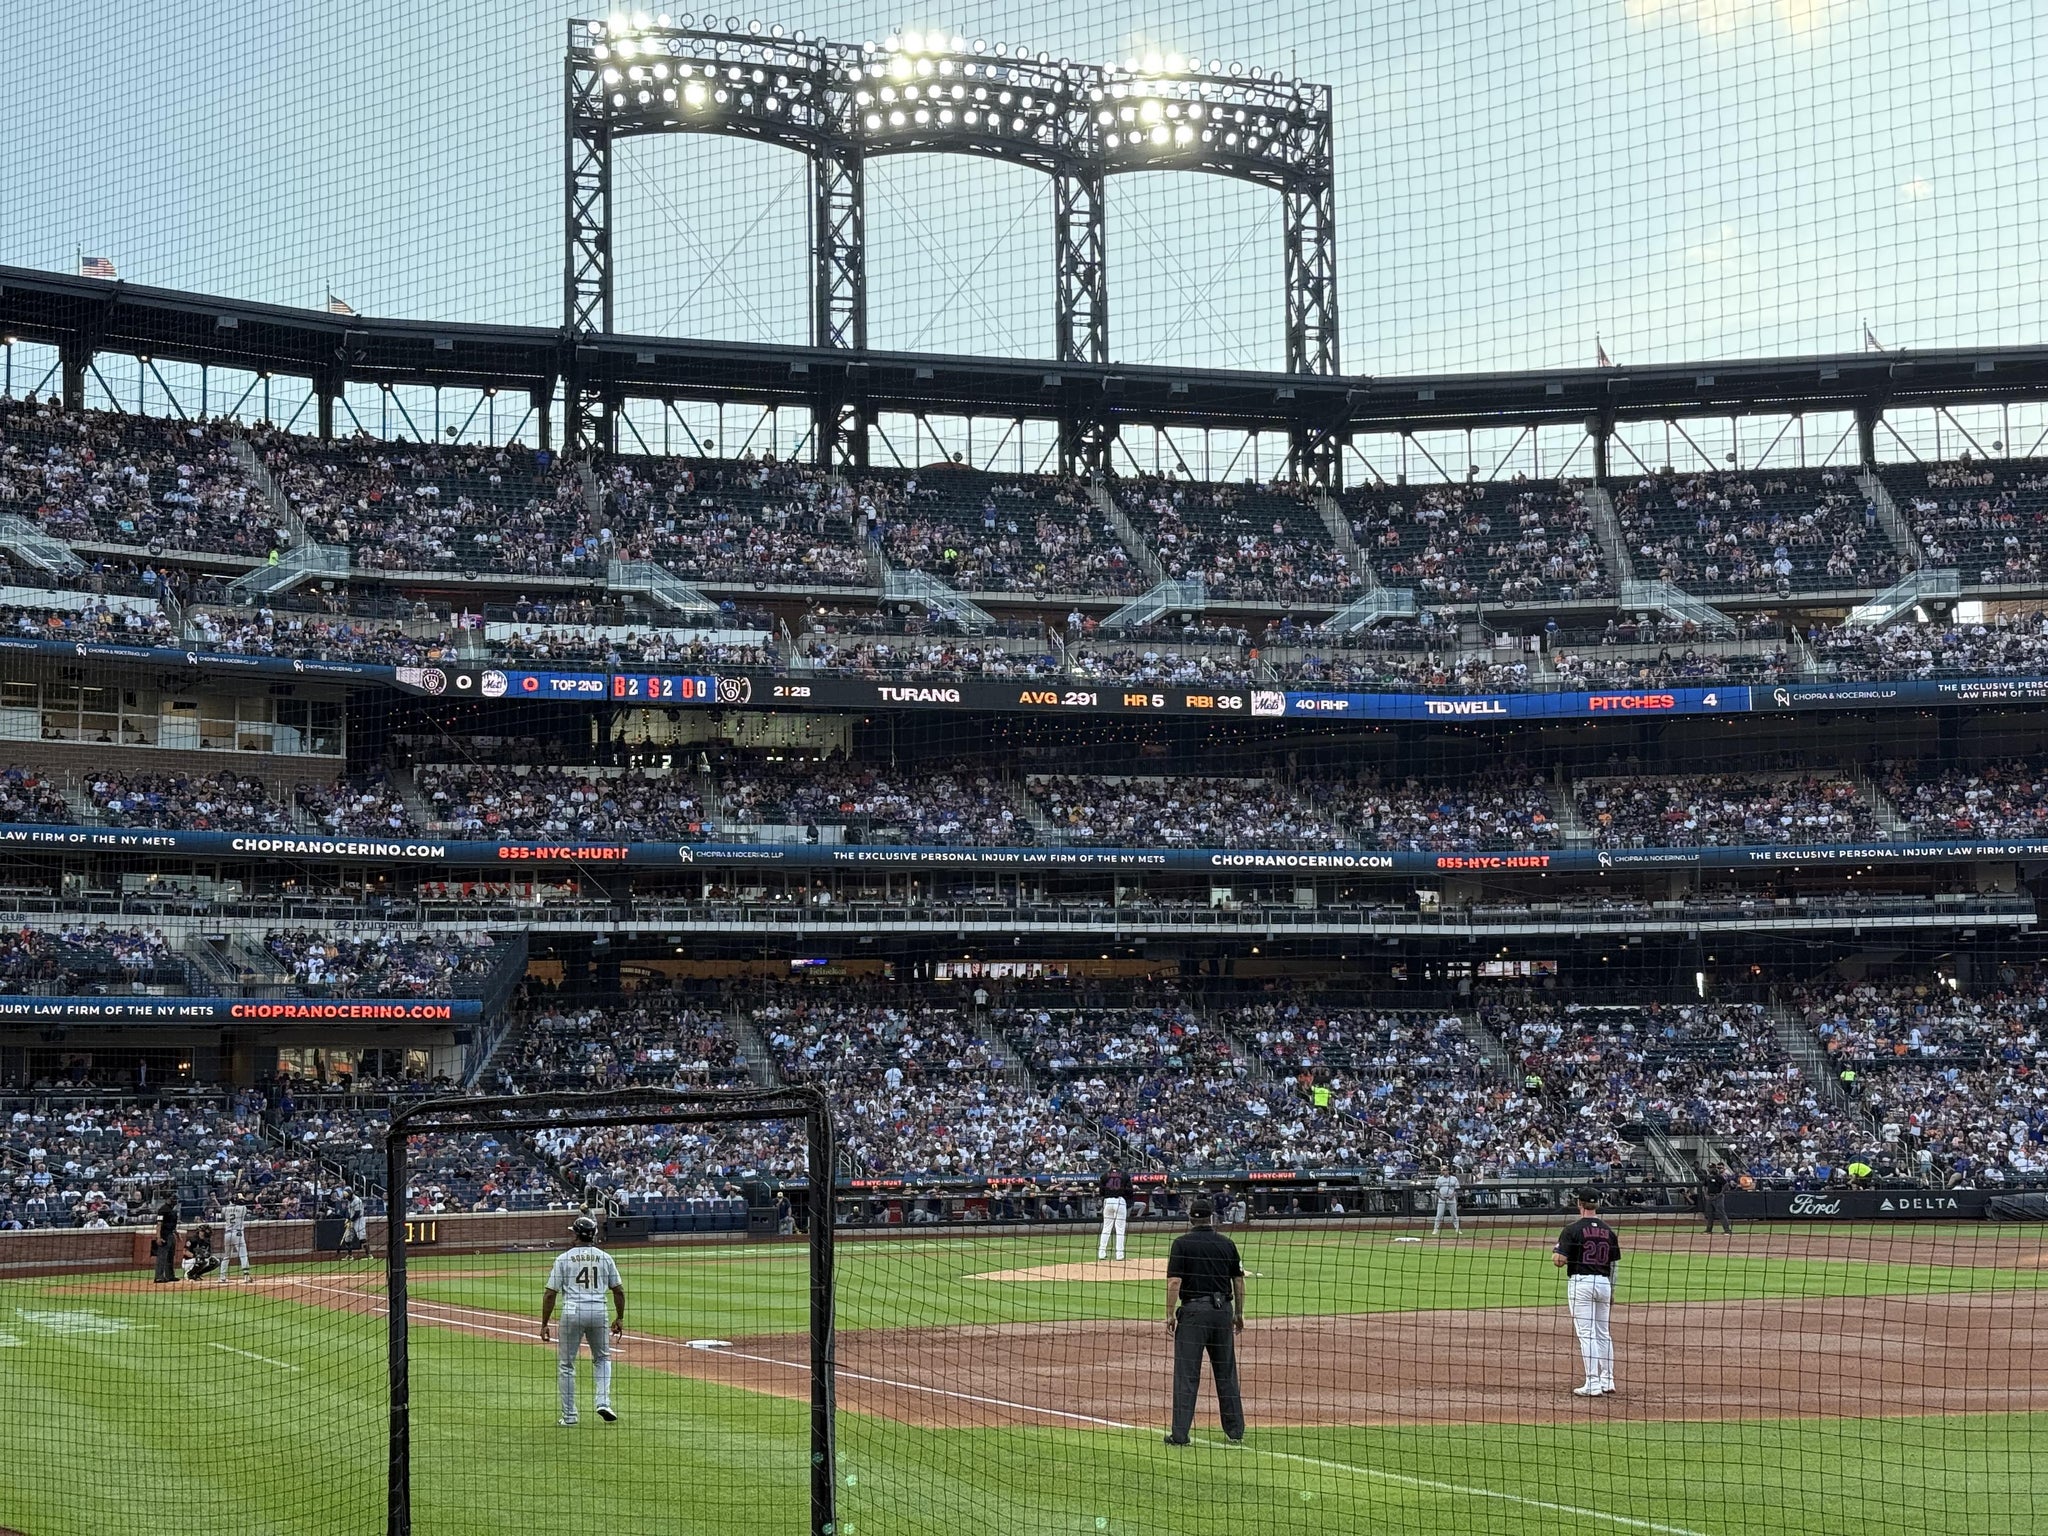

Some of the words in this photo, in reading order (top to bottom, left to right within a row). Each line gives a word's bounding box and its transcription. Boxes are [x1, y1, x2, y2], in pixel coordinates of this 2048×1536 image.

[550, 680, 576, 691] TOP
[578, 680, 603, 692] 2ND
[614, 676, 626, 697] B
[628, 679, 638, 696] 2
[648, 678, 660, 698] S
[662, 680, 672, 696] 2
[1938, 684, 1958, 692] THE
[1960, 682, 2015, 691] EXCLUSIVE
[878, 687, 960, 703] TURANG
[1019, 692, 1058, 705] AVG
[1061, 692, 1098, 706] .291
[1124, 694, 1148, 707] HR
[1152, 694, 1164, 708] 5
[1793, 692, 1828, 700] CHOPRA
[1829, 692, 1834, 700] &
[1836, 691, 1880, 700] NOCERINO,
[1882, 690, 1897, 698] LLP
[1957, 691, 1980, 699] LAW
[1982, 690, 2007, 698] FIRM
[2027, 689, 2046, 697] THE
[1217, 696, 1243, 710] 36
[1256, 698, 1279, 710] Mets
[1424, 700, 1507, 714] TIDWELL
[1589, 695, 1675, 711] PITCHES
[1702, 693, 1718, 706] 4
[0, 832, 28, 841] LAW
[32, 832, 64, 842] FIRM
[69, 834, 87, 843] OF
[92, 834, 116, 844] THE
[121, 836, 138, 845] NY
[142, 836, 176, 846] METS
[232, 838, 445, 858] CHOPRANOCERINO.COM
[1750, 852, 1771, 860] THE
[1775, 850, 1835, 860] EXCLUSIVE
[1839, 850, 1899, 858] PERSONAL
[1902, 848, 1944, 857] INJURY
[1947, 847, 1972, 856] LAW
[1976, 846, 2004, 855] FIRM
[2008, 846, 2024, 854] OF
[2027, 846, 2048, 854] THE
[834, 852, 855, 860] THE
[858, 852, 918, 861] EXCLUSIVE
[921, 852, 978, 862] PERSONAL
[982, 854, 1020, 862] INJURY
[1024, 854, 1047, 862] LAW
[1050, 854, 1076, 863] FIRM
[1079, 854, 1094, 862] OF
[1098, 854, 1118, 863] THE
[1120, 855, 1135, 863] NY
[1138, 856, 1166, 864] METS
[1211, 854, 1393, 868] CHOPRANOCERINO.COM
[1436, 856, 1550, 869] 855-NYC-HURT
[34, 1005, 62, 1014] LAW
[67, 1006, 100, 1015] FIRM
[104, 1006, 124, 1015] OF
[128, 1006, 152, 1015] THE
[158, 1006, 176, 1015] NY
[180, 1006, 214, 1016] METS
[231, 1004, 451, 1018] CHOPRANOCERINO.COM
[1789, 1193, 1840, 1215] Ford
[1900, 1198, 1958, 1210] DELTA
[230, 1214, 236, 1224] 2
[1582, 1240, 1610, 1266] 20
[576, 1266, 598, 1289] 41
